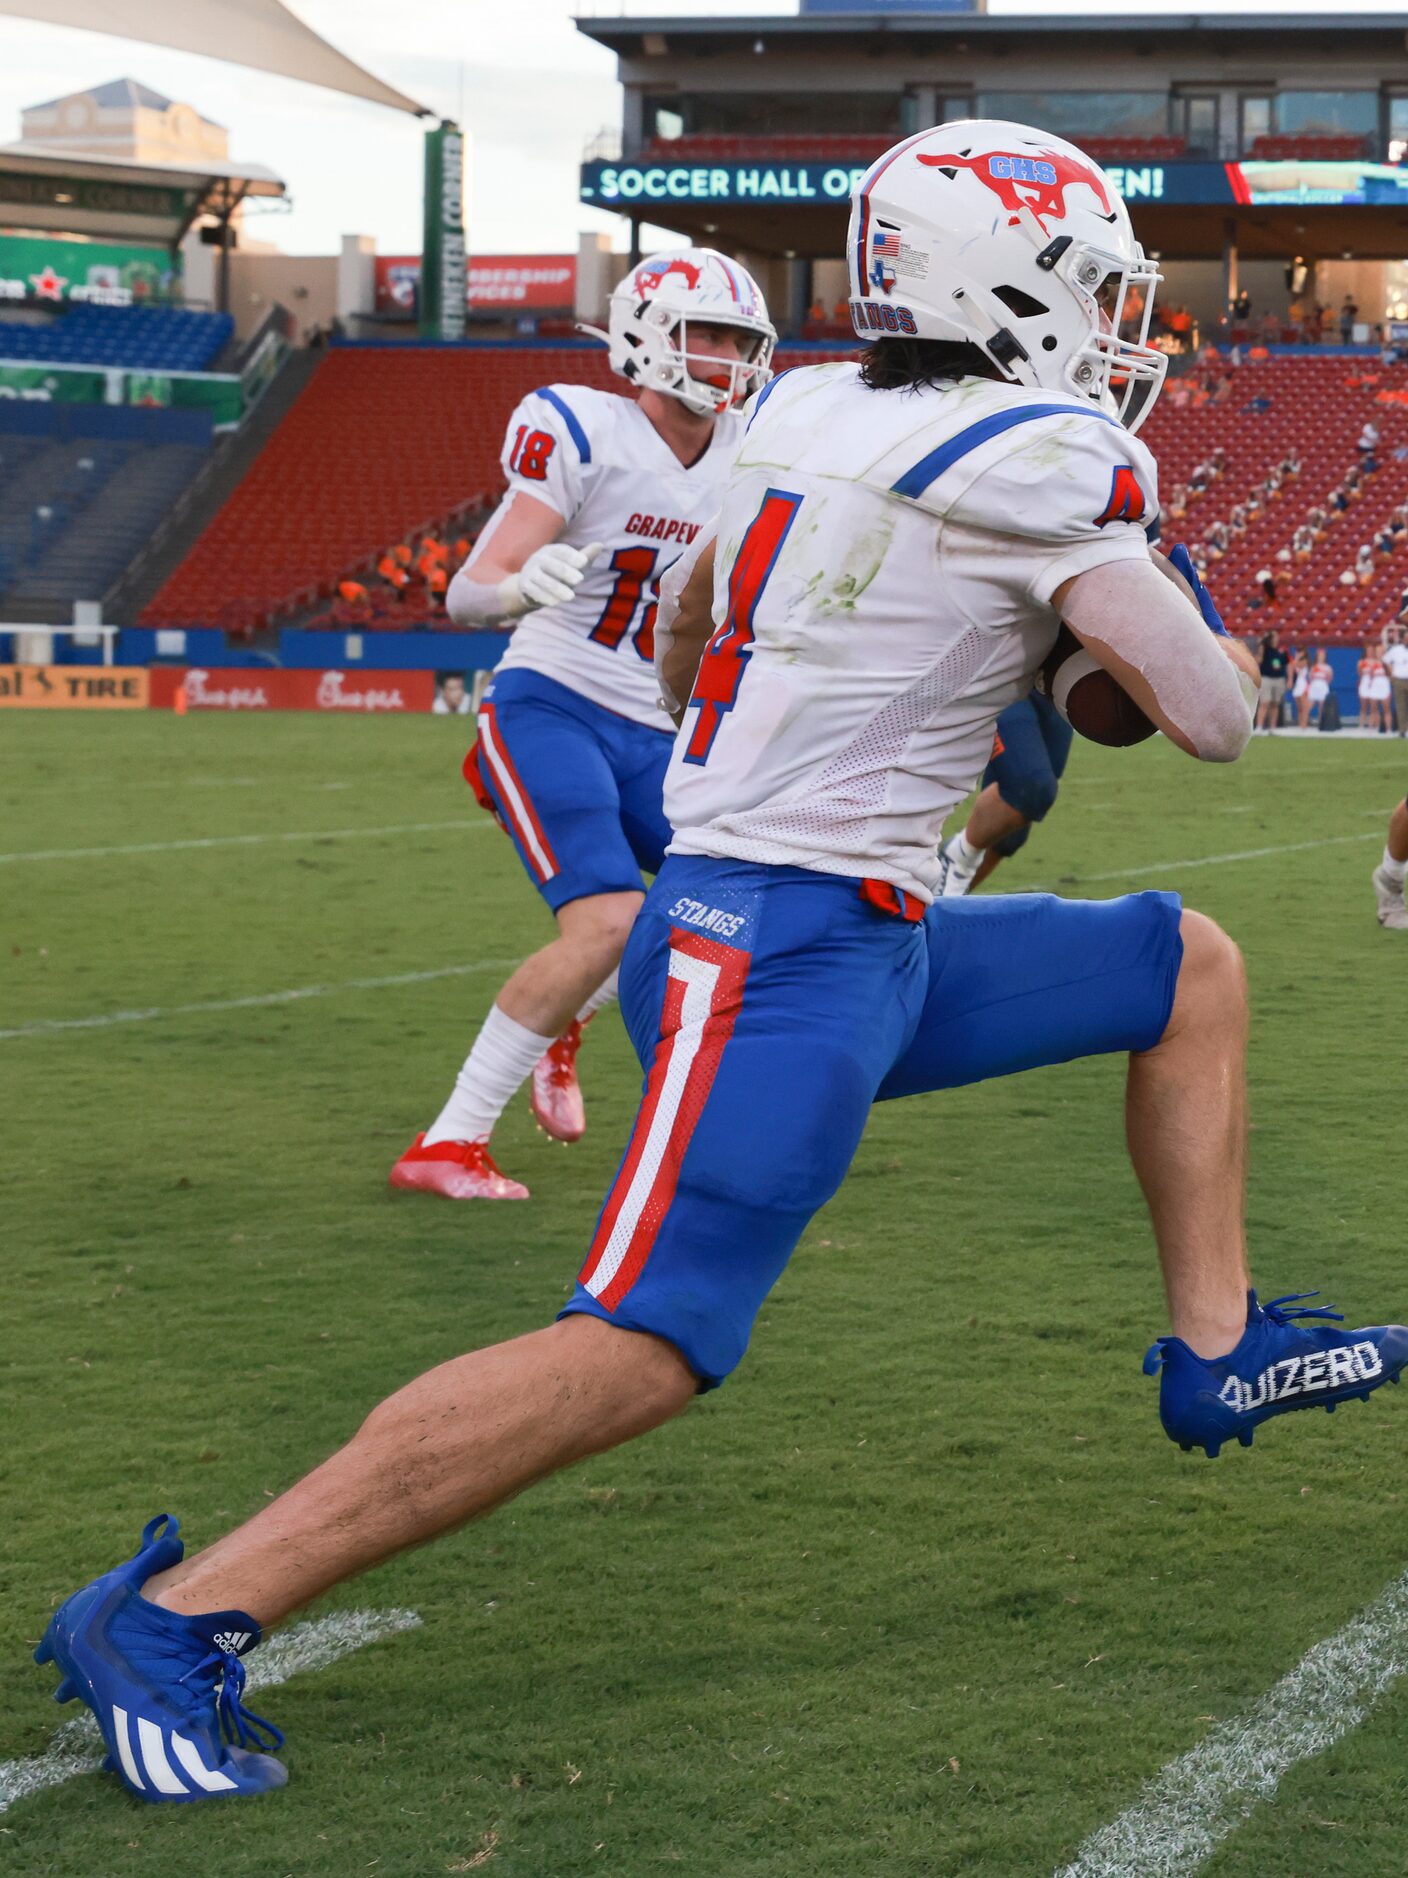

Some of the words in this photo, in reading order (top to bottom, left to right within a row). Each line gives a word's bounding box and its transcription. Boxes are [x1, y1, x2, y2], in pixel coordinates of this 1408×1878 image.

[600, 168, 729, 197] SOCCER
[736, 168, 816, 197] HALL
[822, 168, 866, 197] OF
[988, 155, 1057, 186] GHS
[1106, 168, 1164, 198] EN!
[509, 424, 556, 481] 18
[624, 512, 703, 546] GRAPEV
[682, 486, 805, 767] 4
[65, 676, 141, 698] TIRE
[667, 896, 746, 938] STANGS
[213, 1633, 238, 1656] adid
